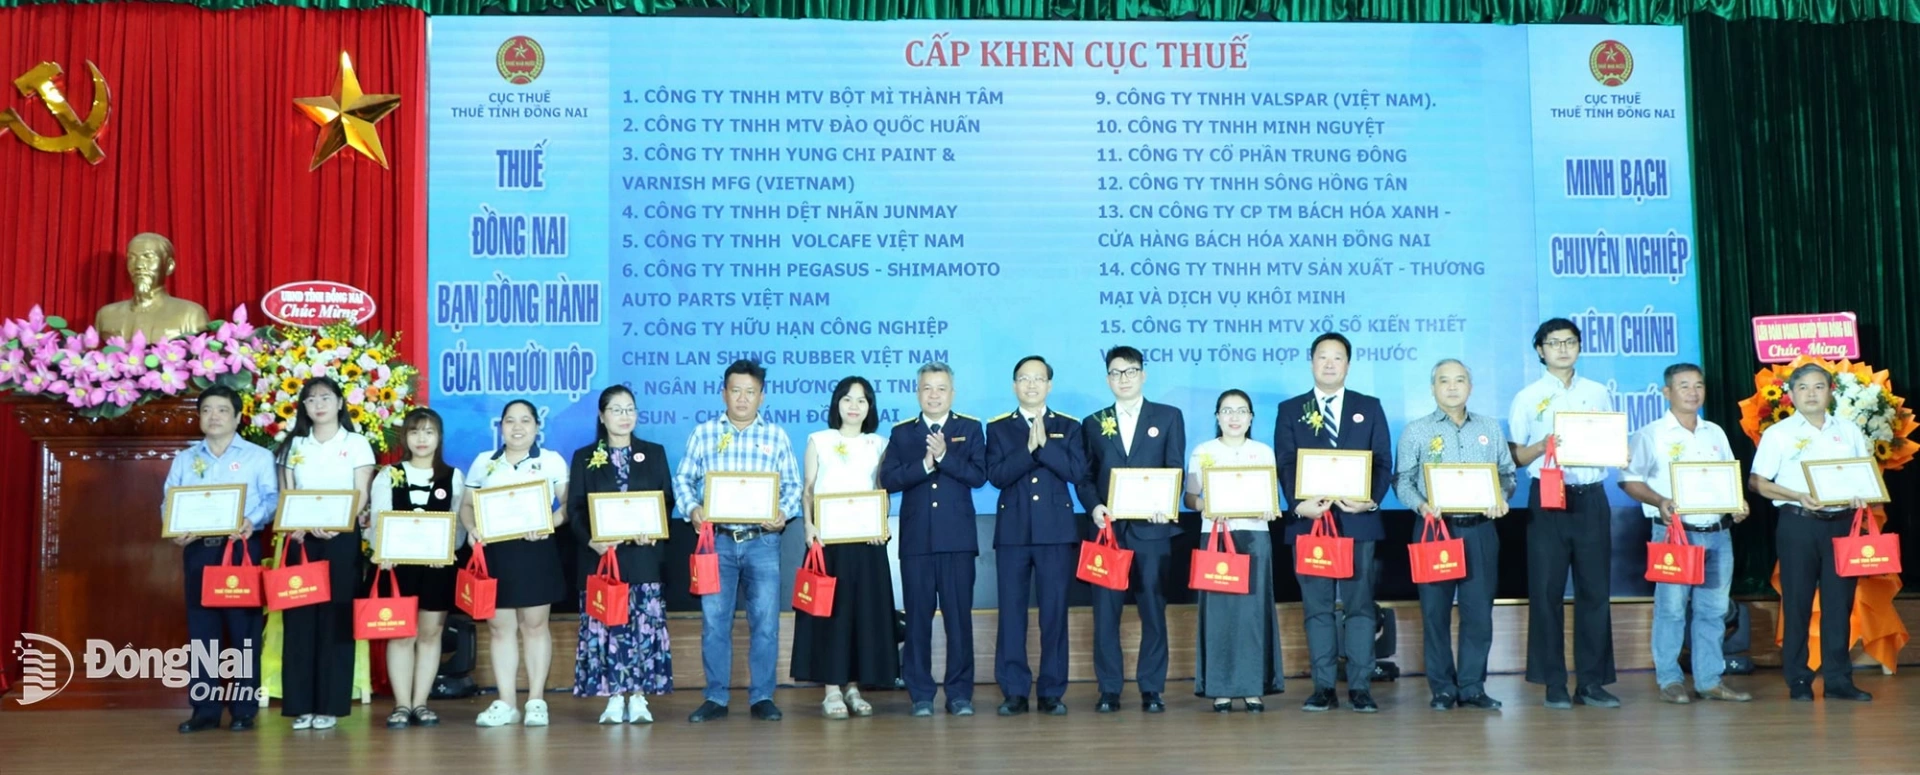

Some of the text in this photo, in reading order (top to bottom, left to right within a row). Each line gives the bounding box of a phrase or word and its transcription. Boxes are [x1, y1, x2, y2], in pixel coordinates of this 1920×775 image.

[905, 32, 1250, 75] CẤP KHEN CỤC THUẾ
[488, 89, 551, 105] CỤC THUẾ
[643, 84, 1004, 108] CÔNG TNHH MTV BỘT MÌ THÀNH TÂM
[1115, 86, 1436, 111] CÔNG TNHH VALSPAR (VIỆT NAM).
[1584, 94, 1608, 106] CỤC
[451, 104, 486, 118] THUẾ
[565, 107, 588, 118] NAI
[1655, 108, 1676, 119] NAI
[643, 113, 980, 137] CÔNG TNHH MTV ĐÀO QUỐC HUẤN
[1126, 114, 1385, 138] CÔNG TNHH MINH NGUYỆT
[495, 138, 548, 188] THUẾ
[643, 142, 937, 162] CÔNG TNHH YUNG CHI PAINT
[1127, 143, 1407, 163] CÔNG CỔ PHẦN TRUNG ĐÔNG
[621, 174, 855, 194] VARNISH MFG (VIETNAM)
[1128, 171, 1407, 191] CÔNG TNHH SÔNG HỒNG TÂN
[1566, 158, 1668, 202] MINH BẠCH
[643, 200, 958, 223] CÔNG TNHH DỆT NHÃN JUNMAY
[1128, 199, 1439, 219] CN CÔNG CP TM BÁCH HÓA XANH
[472, 205, 566, 256] ĐỒNG NAI
[643, 228, 964, 252] CÔNG TNHH VOLCAFE VIỆT NAM
[1097, 228, 1431, 248] CỬA HÀNG BÁCH HÓA XANH ĐỒNG NAI
[643, 258, 1000, 278] CÔNG TNHH PEGASUS SHIMAMOTO
[1129, 256, 1485, 276] CÔNG TNHH MTV SẢN XUẤT THƯƠNG
[1551, 231, 1688, 282] CHUYÊN NGHIỆP
[437, 273, 599, 330] BẠN ĐỒNG HÀNH
[621, 286, 830, 310] AUTO PARTS VIỆT NAM
[1098, 285, 1345, 308] MẠI VÀ DỊCH VỤ KHÔI MINH
[280, 304, 359, 321] Chúc Mừng
[1130, 314, 1182, 334] CÔNG
[1212, 318, 1263, 333] TNHH
[1267, 318, 1305, 333] MTV
[1367, 313, 1410, 333] KIẾN
[1414, 313, 1467, 332] THIẾT
[643, 315, 949, 339] CÔNG HỮU HẠN CÔNG NGHIỆP
[1571, 308, 1676, 354] IÊM CHÍNH
[621, 346, 949, 368] CHIN LAN SHING RUBBER VIỆT NAM
[1180, 343, 1418, 366] VỤ TỔNG HỢP PHƯỚC
[1768, 343, 1801, 357] Chúc
[442, 341, 594, 399] CỦA NGƯỜI NỘP
[644, 376, 697, 395] NGÂN
